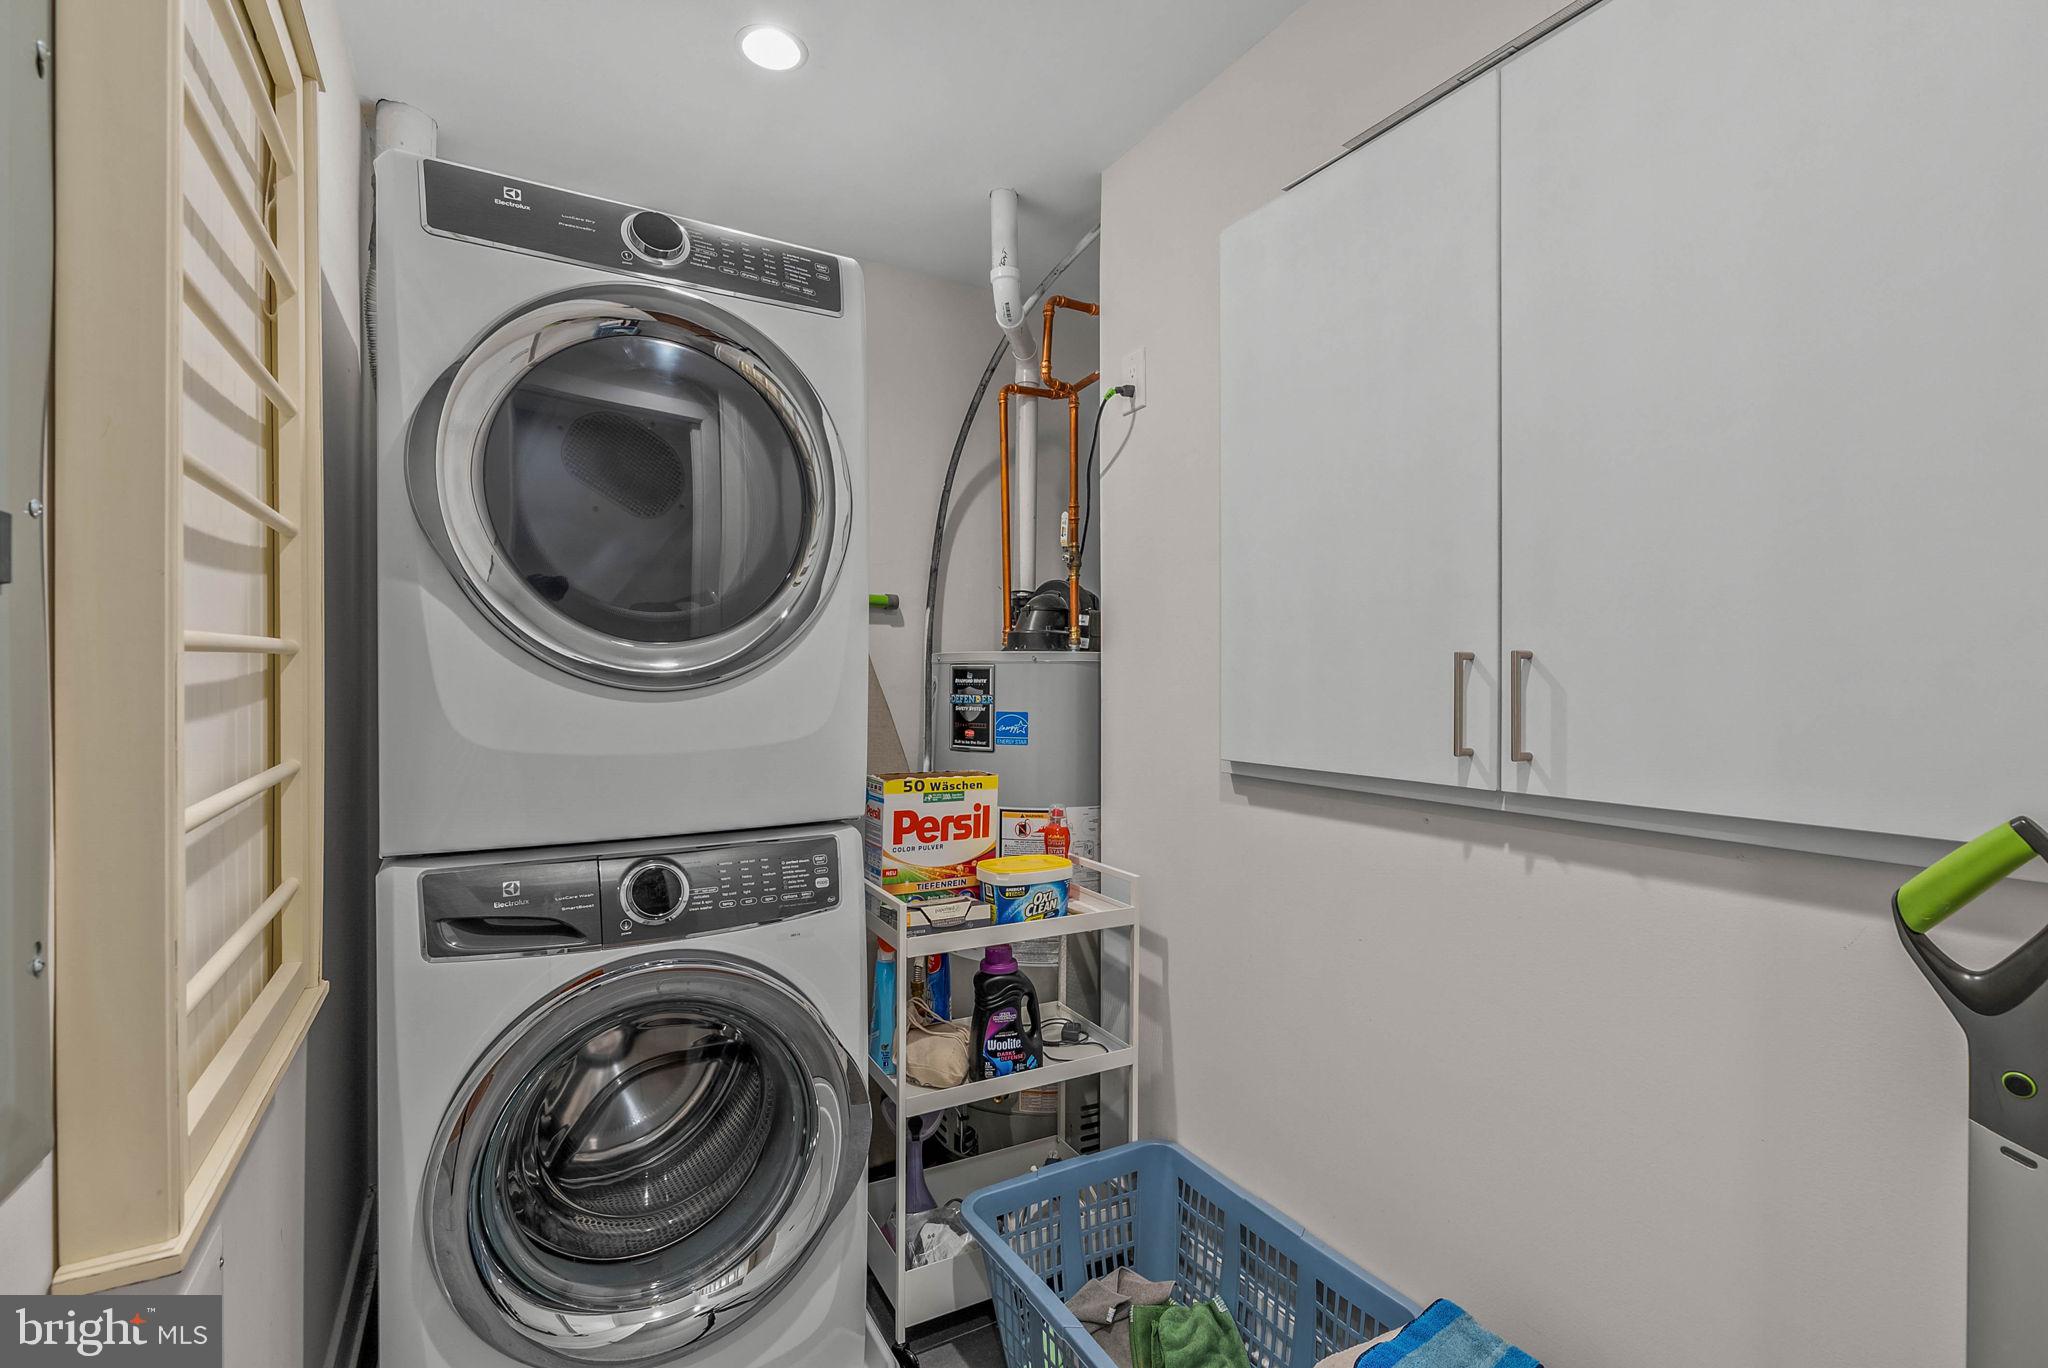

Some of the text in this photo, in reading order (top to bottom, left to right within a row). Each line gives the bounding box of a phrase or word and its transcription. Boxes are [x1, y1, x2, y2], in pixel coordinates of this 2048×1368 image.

[494, 198, 531, 211] Electrolux
[950, 694, 993, 704] DEFENDER
[903, 780, 983, 793] 50 Wäschen
[892, 802, 991, 845] Persil
[892, 843, 944, 853] COLOR PULVER
[916, 878, 967, 890] TIEFENREIN
[493, 899, 530, 909] Electrolux
[1033, 890, 1053, 905] OXI
[1025, 898, 1057, 917] CLEAN
[987, 1037, 1022, 1051] Woolite
